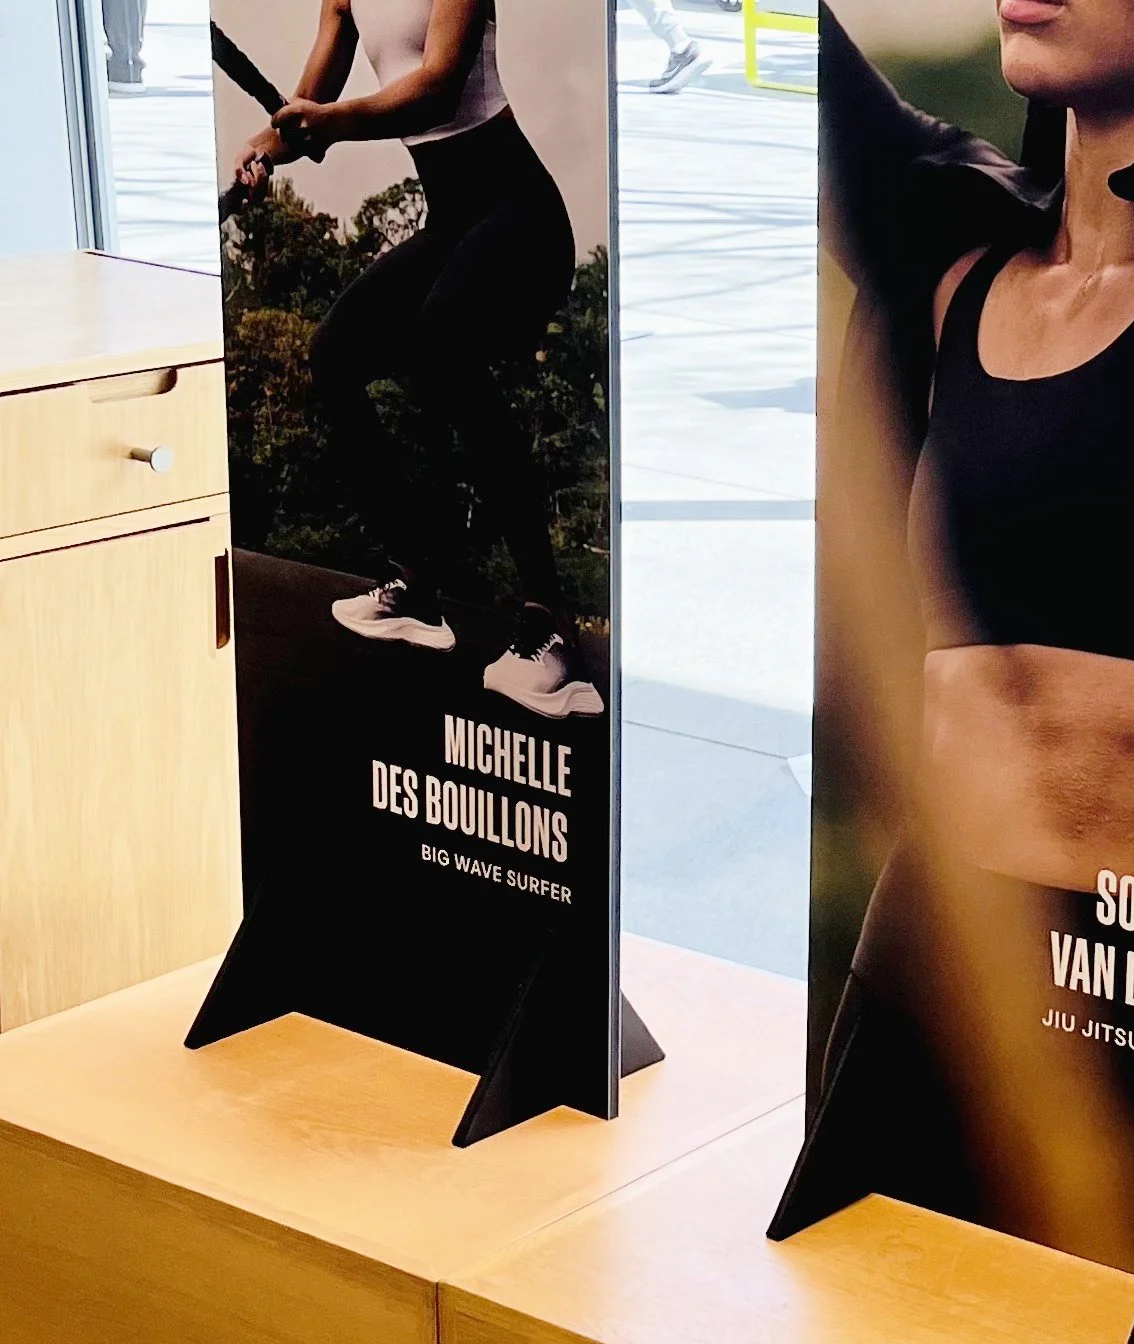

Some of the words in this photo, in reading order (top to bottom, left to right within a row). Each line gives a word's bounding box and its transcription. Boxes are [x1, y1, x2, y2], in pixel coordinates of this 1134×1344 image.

[444, 713, 572, 798] MICHELLE
[372, 759, 418, 819] DES
[425, 774, 568, 863] BOUILLONS
[421, 843, 450, 866] BIG
[454, 853, 502, 883] WAVE
[506, 869, 572, 905] SURFER
[1050, 930, 1116, 1000] VAN
[1041, 1008, 1076, 1033] JIU
